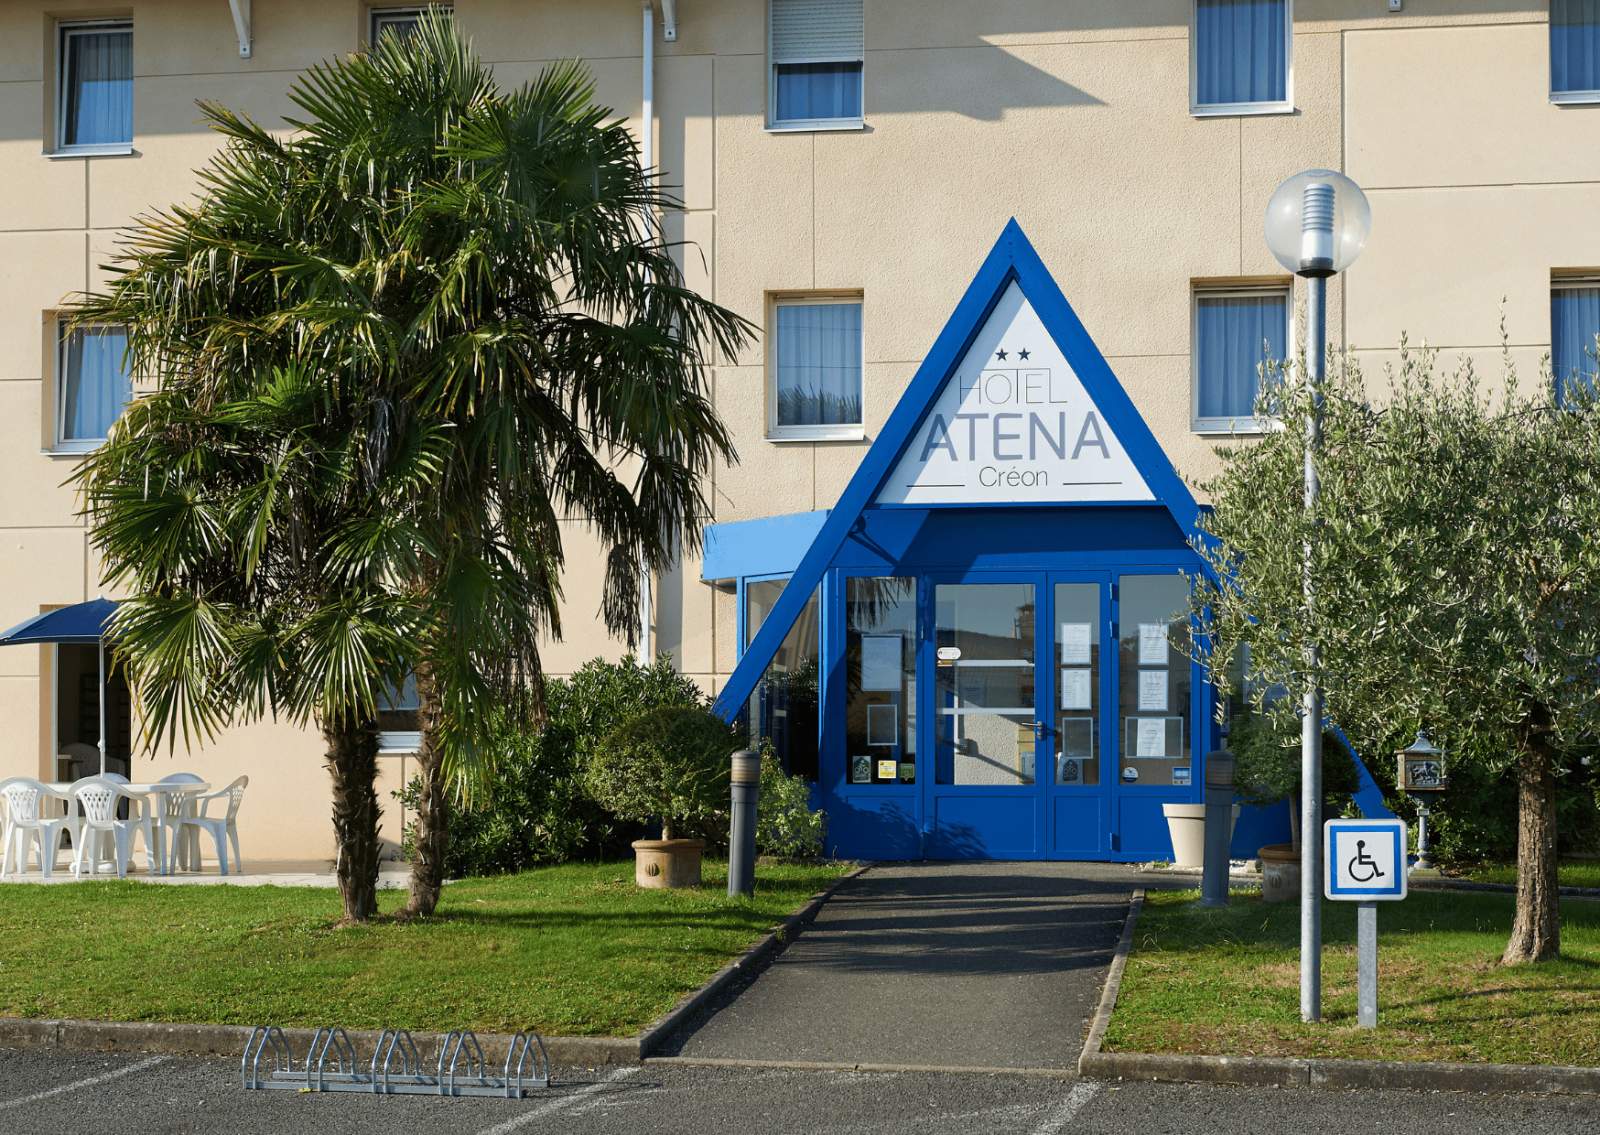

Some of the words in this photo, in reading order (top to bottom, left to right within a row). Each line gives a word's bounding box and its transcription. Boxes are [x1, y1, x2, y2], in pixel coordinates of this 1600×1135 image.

[959, 367, 1068, 405] HOTEL
[919, 410, 1111, 462] ATENA
[978, 465, 1048, 487] Créon
